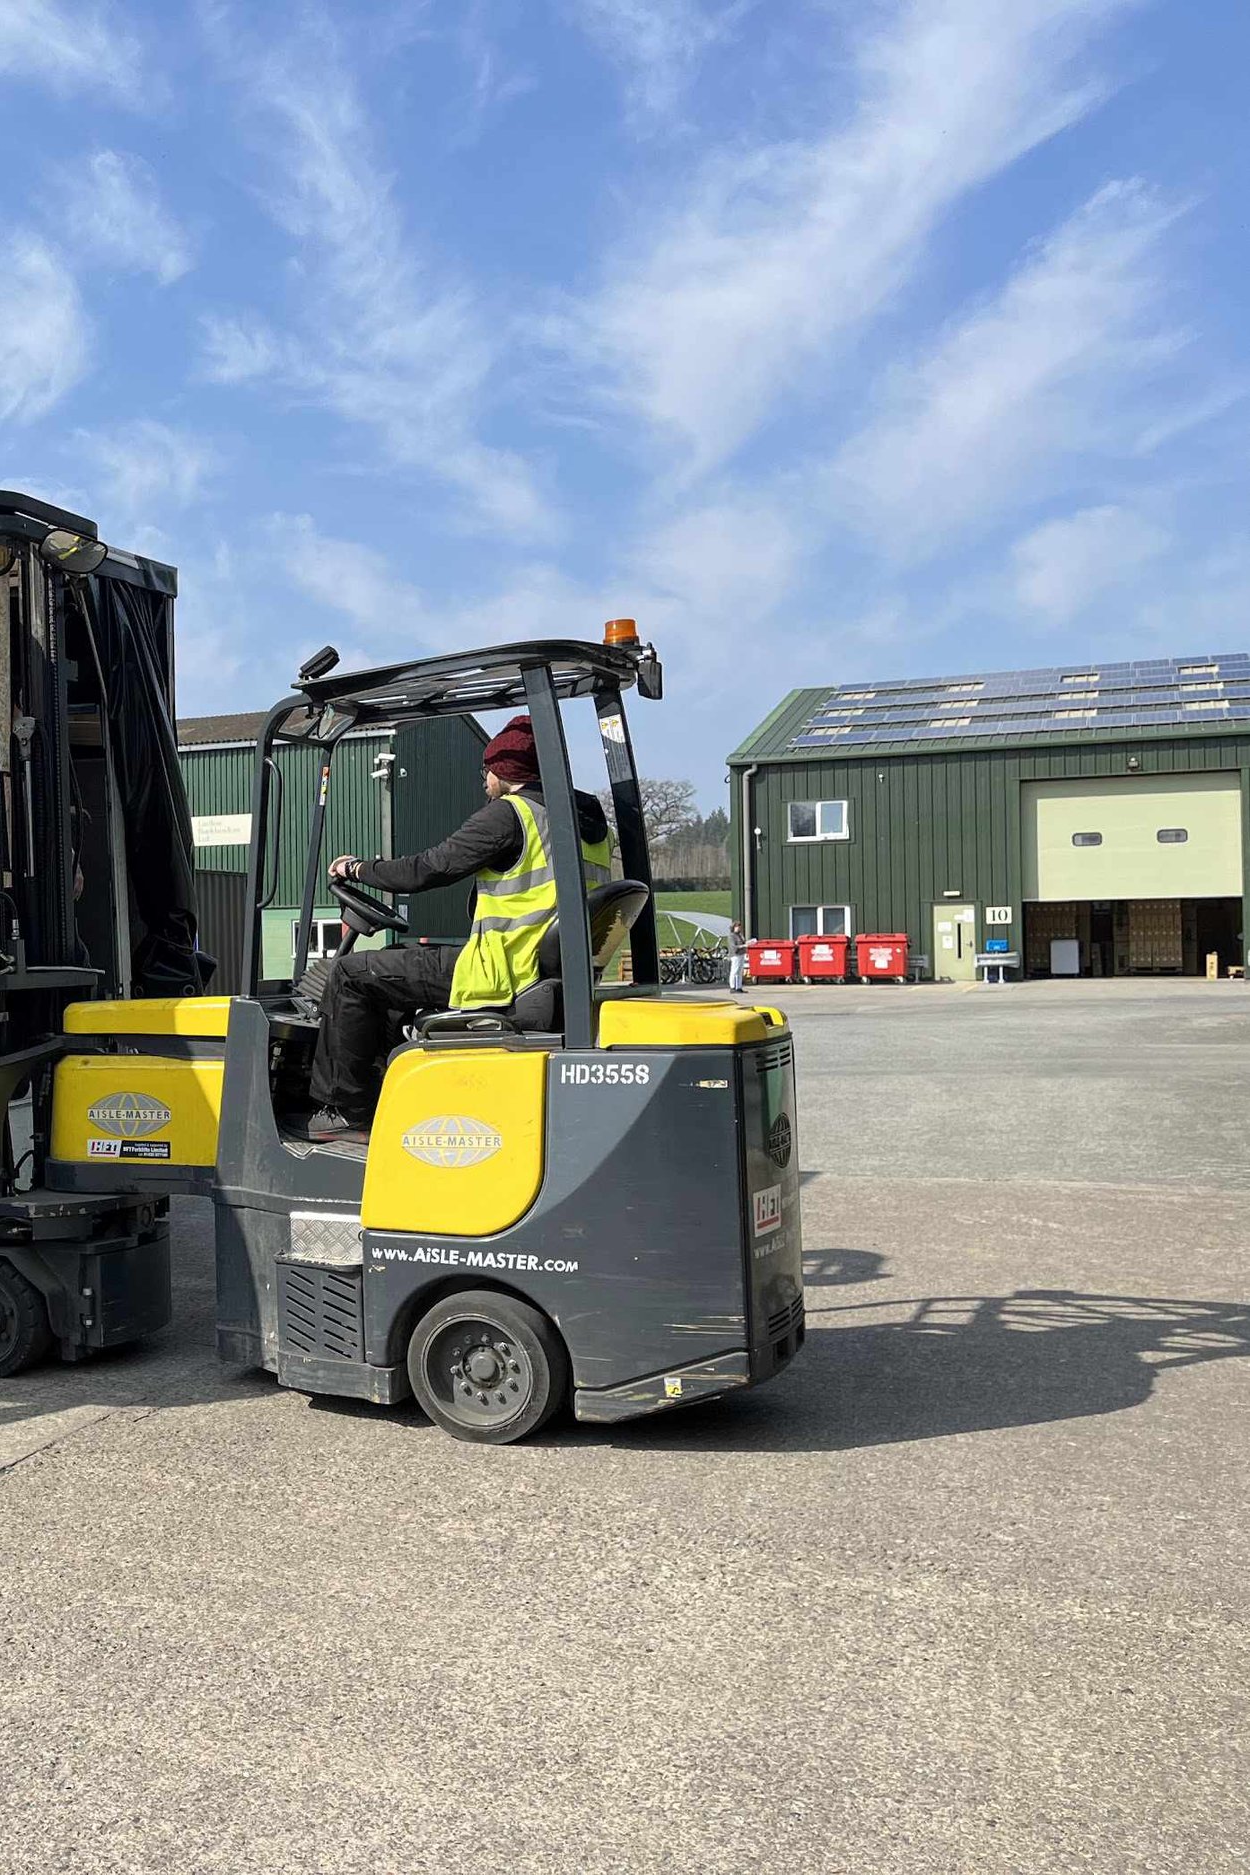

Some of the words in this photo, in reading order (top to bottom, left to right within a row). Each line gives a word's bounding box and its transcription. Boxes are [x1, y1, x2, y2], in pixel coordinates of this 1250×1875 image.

[991, 909, 1008, 921] 10
[89, 1110, 170, 1119] AISLE-MASTER
[403, 1136, 502, 1147] AISLE-MASTER
